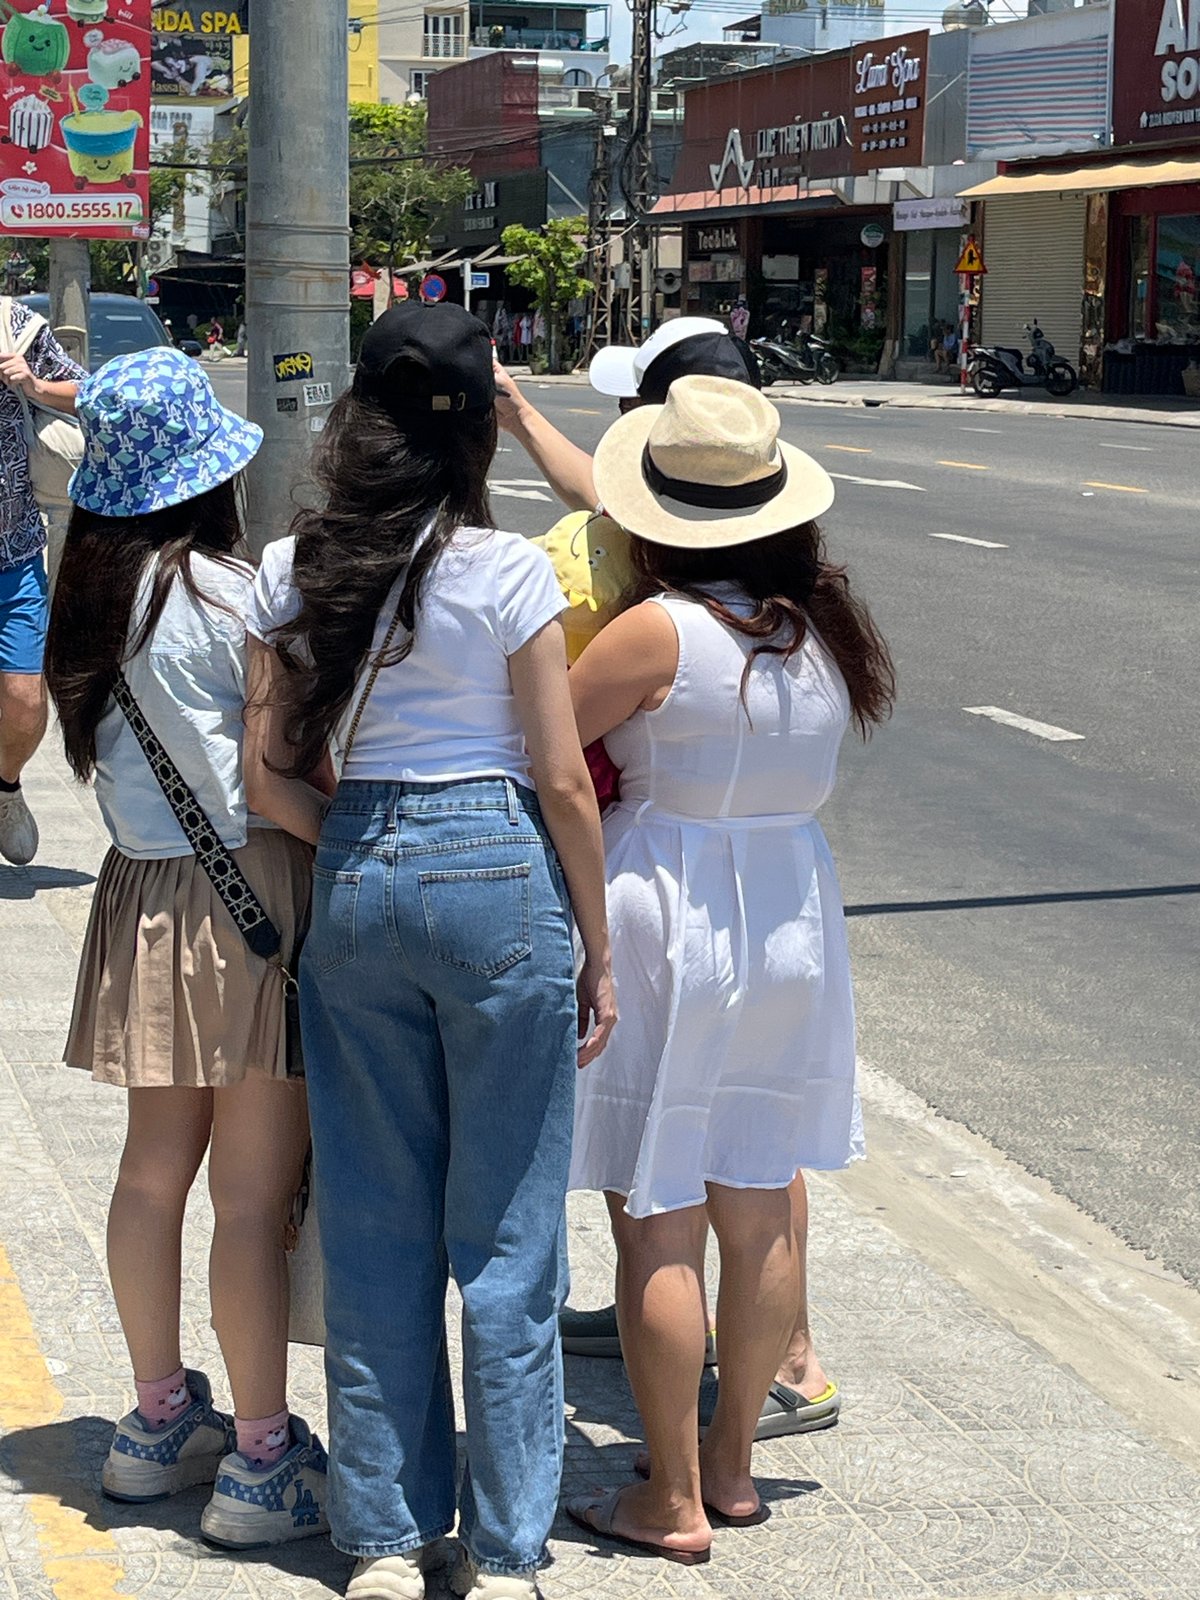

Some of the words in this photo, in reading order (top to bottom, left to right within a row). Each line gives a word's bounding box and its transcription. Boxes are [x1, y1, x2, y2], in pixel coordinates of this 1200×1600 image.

[200, 11, 242, 34] SPA
[1161, 56, 1200, 102] SO
[26, 201, 134, 219] 1800.5555.17
[291, 1479, 320, 1527] LA
